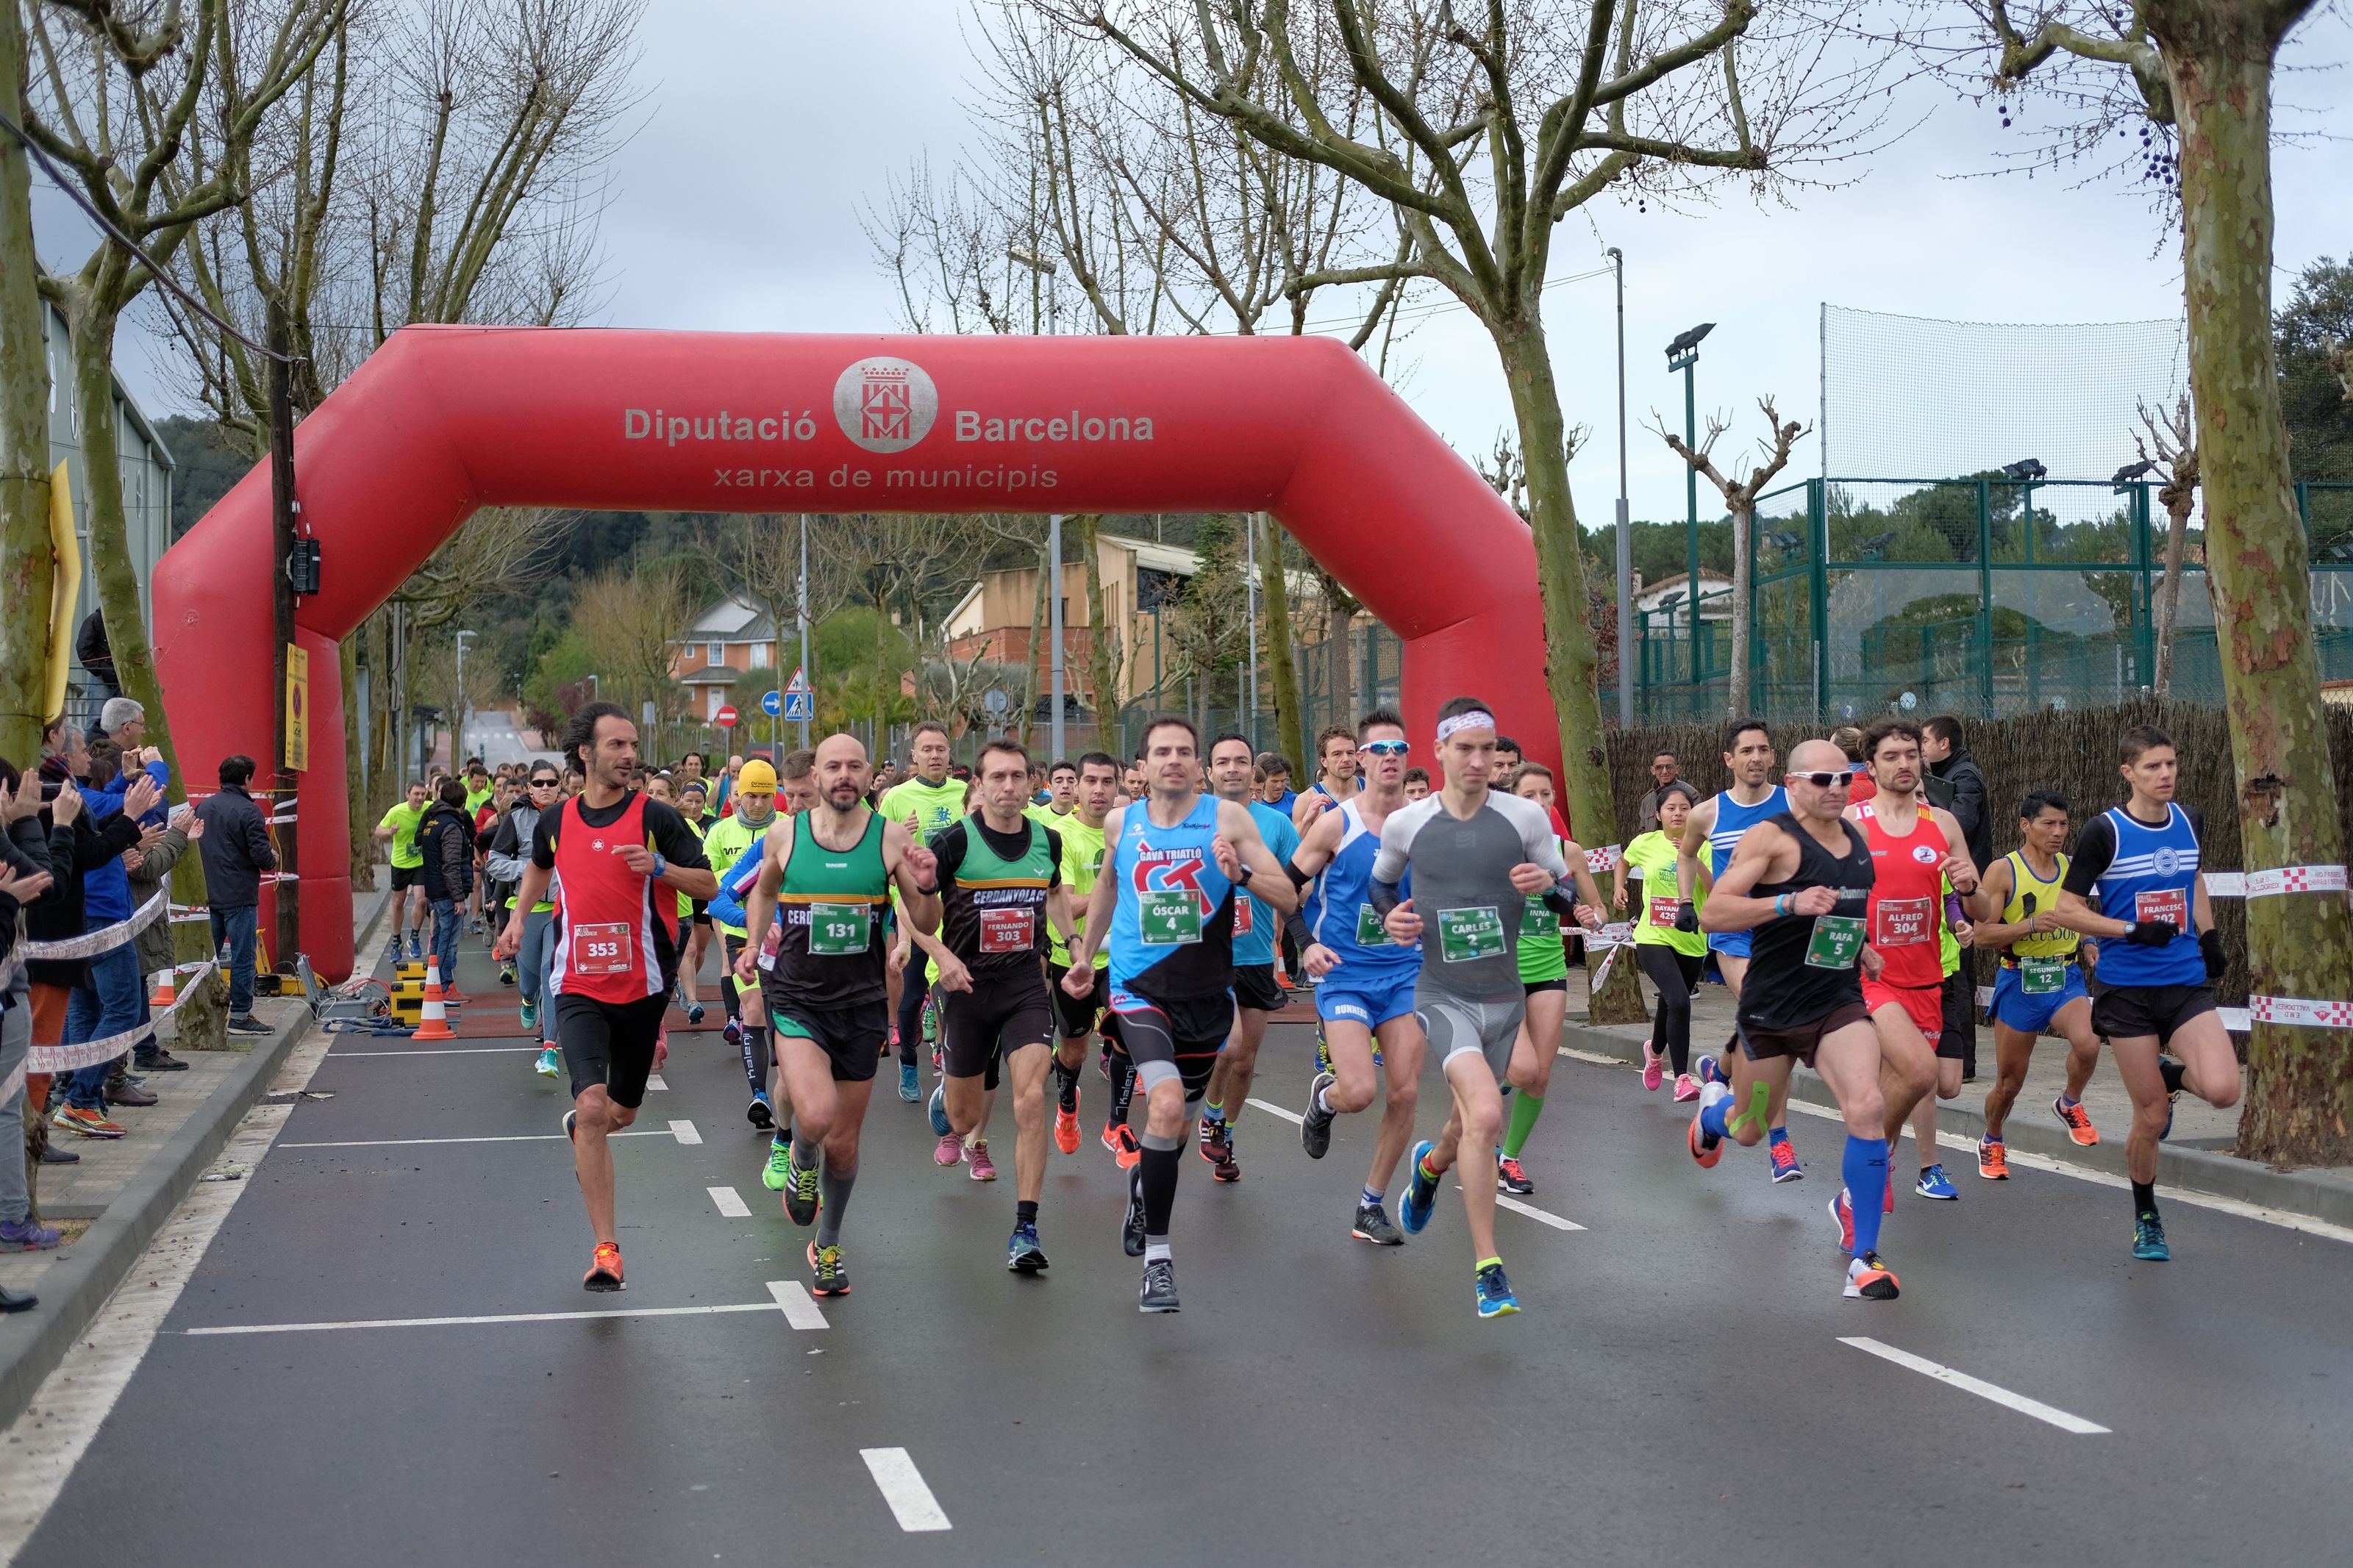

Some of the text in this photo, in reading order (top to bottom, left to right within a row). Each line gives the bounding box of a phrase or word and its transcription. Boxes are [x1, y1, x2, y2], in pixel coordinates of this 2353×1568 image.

[625, 409, 1154, 446] Diputació Barcelona
[714, 464, 1058, 492] xarxa de municipis
[1140, 846, 1202, 861] GAVÀ TRIATLÓ
[973, 889, 1035, 904] CERDANYOLA
[1152, 905, 1189, 916] ÓSCAR
[1529, 909, 1550, 917] INNA
[2144, 903, 2182, 913] FRANCESC
[1535, 917, 1541, 927] 1
[1660, 912, 1676, 920] 426
[1888, 913, 1924, 922] ALFRED
[988, 921, 1029, 930] FERNANDO
[1166, 917, 1176, 930] 4
[1451, 921, 1491, 934] CARLES
[1893, 922, 1918, 934] 304
[825, 923, 856, 937] 131
[996, 931, 1021, 942] 303
[1466, 934, 1478, 946] 2
[1829, 931, 1853, 942] RAFA
[588, 942, 618, 957] 353
[1834, 943, 1844, 955] 5
[2029, 966, 2061, 974] SEGUNDO
[2039, 974, 2052, 984] 12
[1335, 1004, 1368, 1020] RUNNERS
